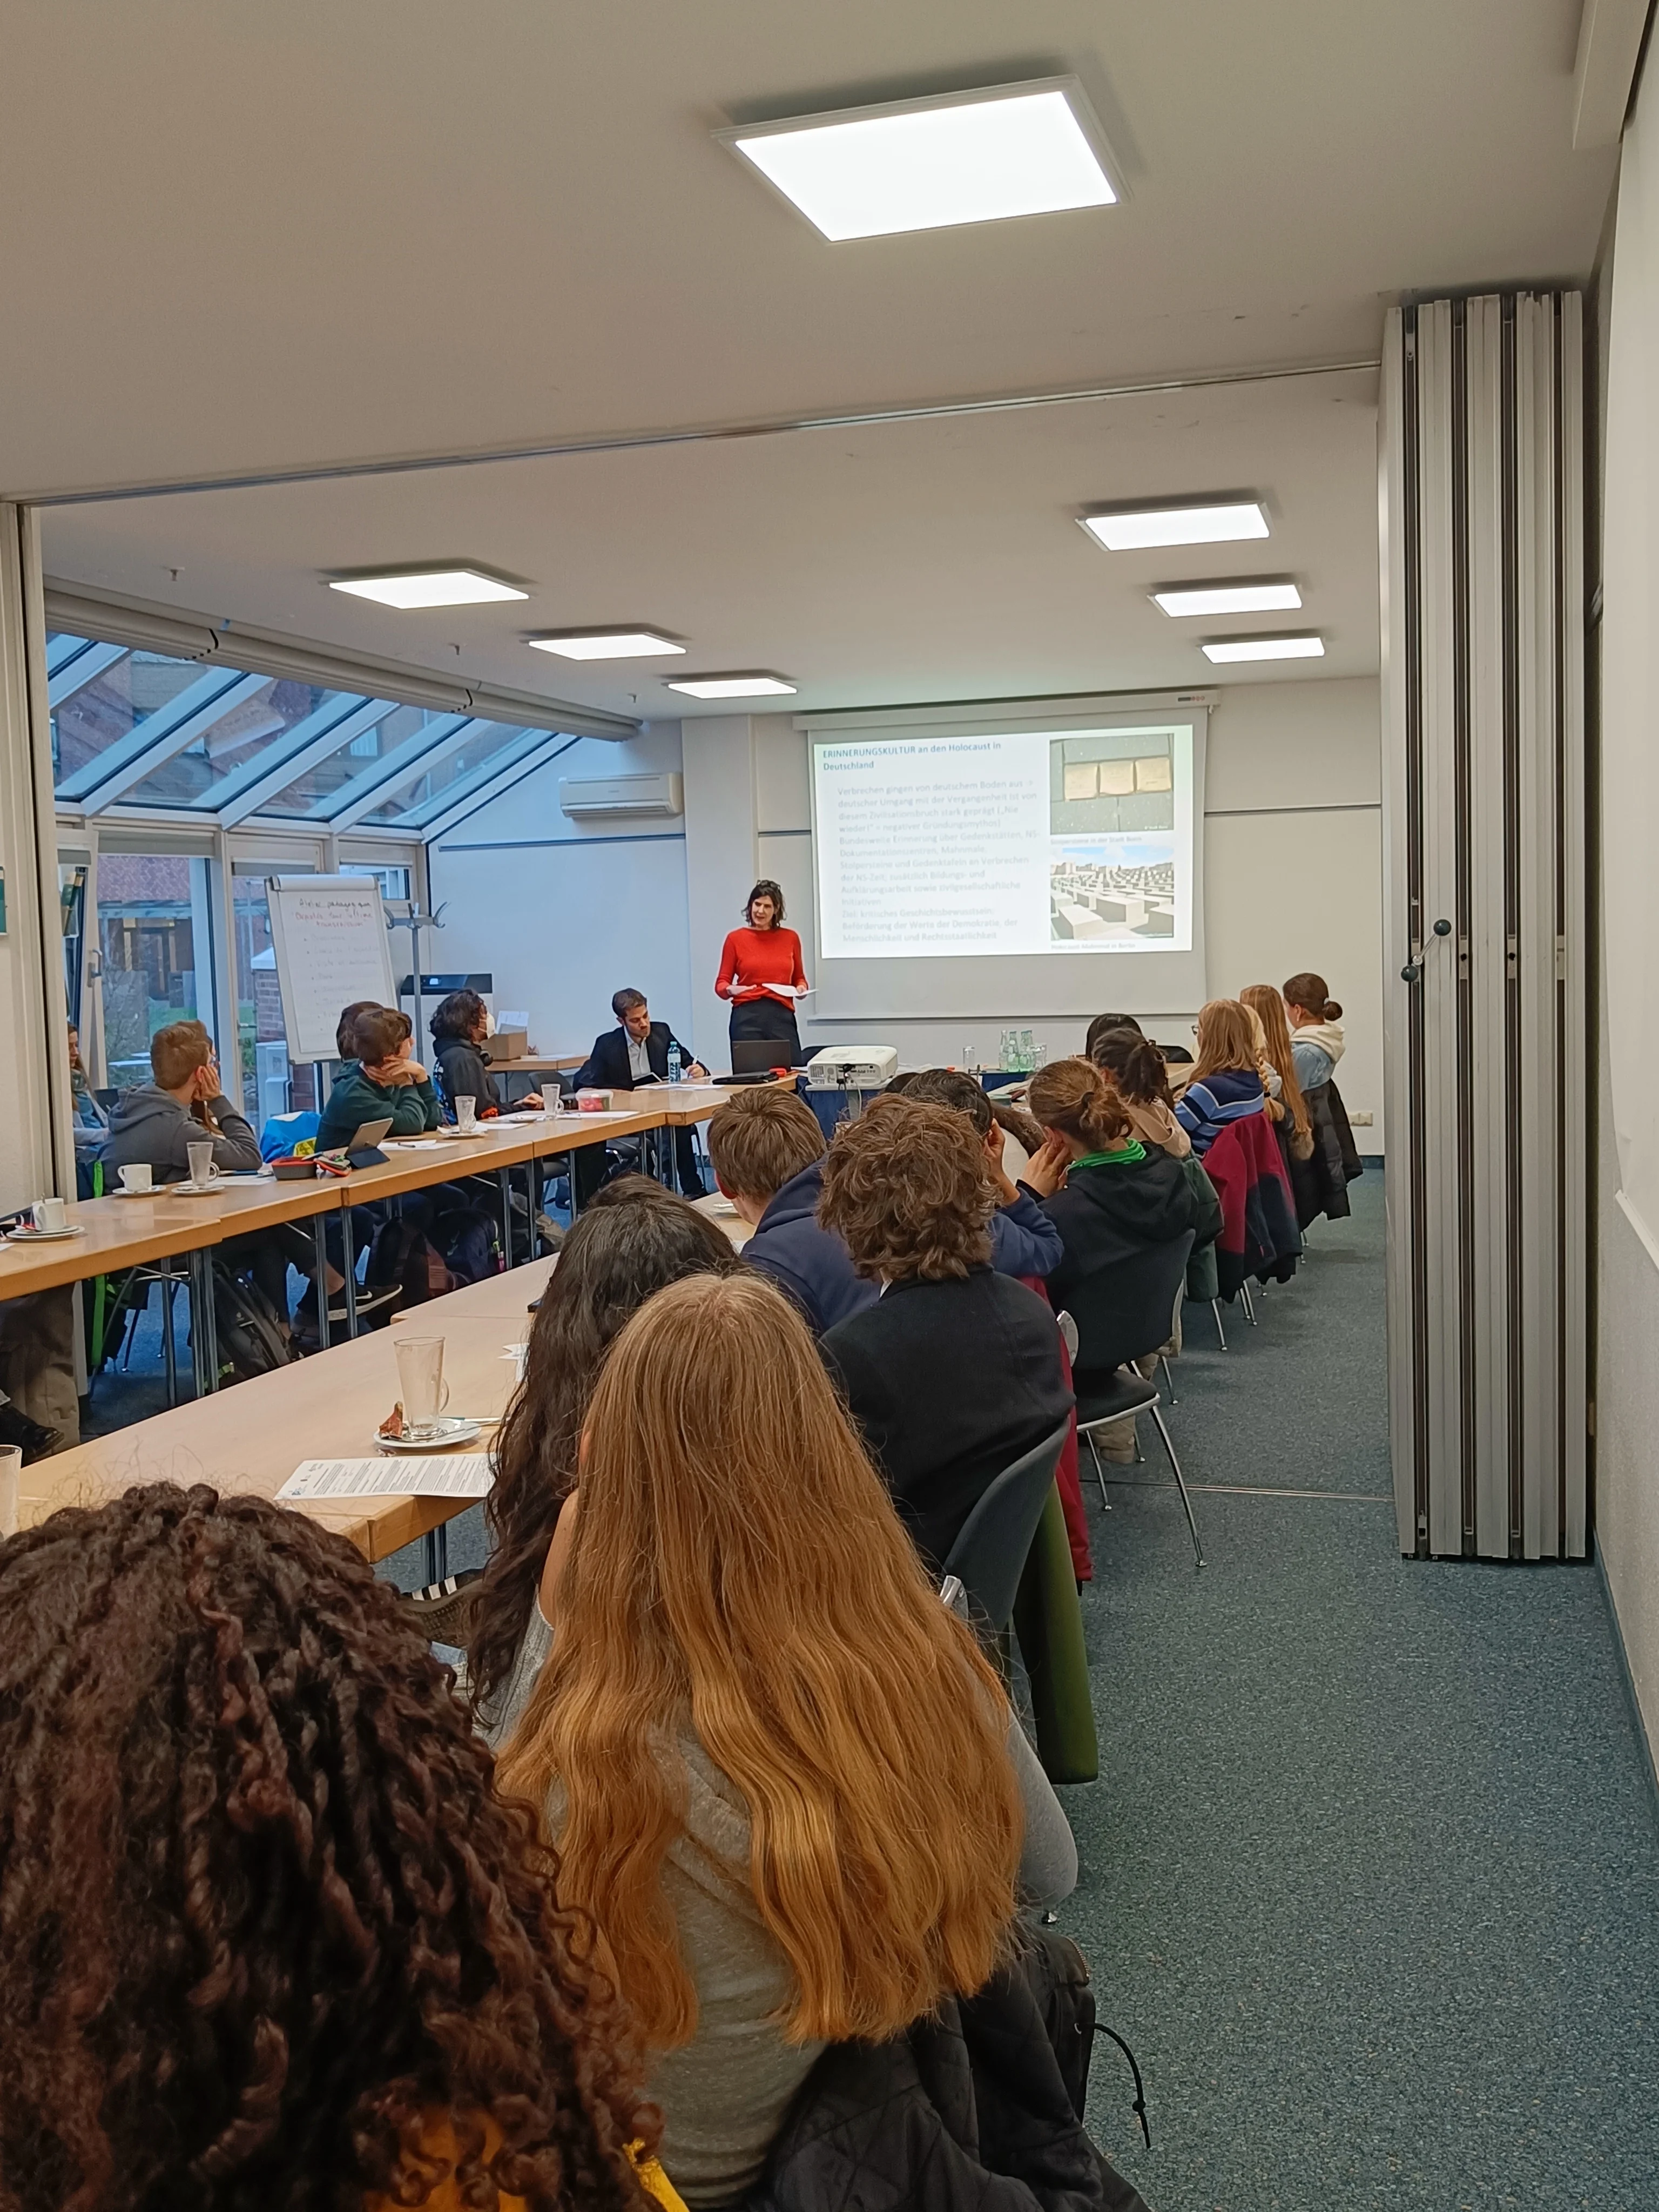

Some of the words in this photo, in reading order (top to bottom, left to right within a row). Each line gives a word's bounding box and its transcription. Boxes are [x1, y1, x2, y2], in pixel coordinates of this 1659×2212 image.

[823, 746, 915, 758] ERINNERUNGSKULTUR
[949, 743, 990, 751] Holocaust
[993, 741, 1001, 750] in
[824, 761, 874, 771] Deutschland
[838, 786, 884, 795] Verbrechen
[886, 785, 913, 795] gingen
[933, 782, 977, 791] deutschem
[980, 780, 1006, 789] Boden
[838, 799, 878, 808] deutscher
[880, 798, 913, 807] Umgang
[947, 793, 1007, 804] Vergangenheit
[941, 808, 961, 816] stark
[882, 823, 920, 832] negativer
[893, 835, 937, 844] Erinnerung
[981, 856, 1029, 865] Verbrechen
[969, 870, 985, 878] und
[914, 884, 936, 892] sowie
[894, 921, 907, 929] der
[909, 921, 934, 929] Werte
[936, 920, 950, 928] der
[1004, 918, 1018, 926] der
[904, 933, 919, 941] und
